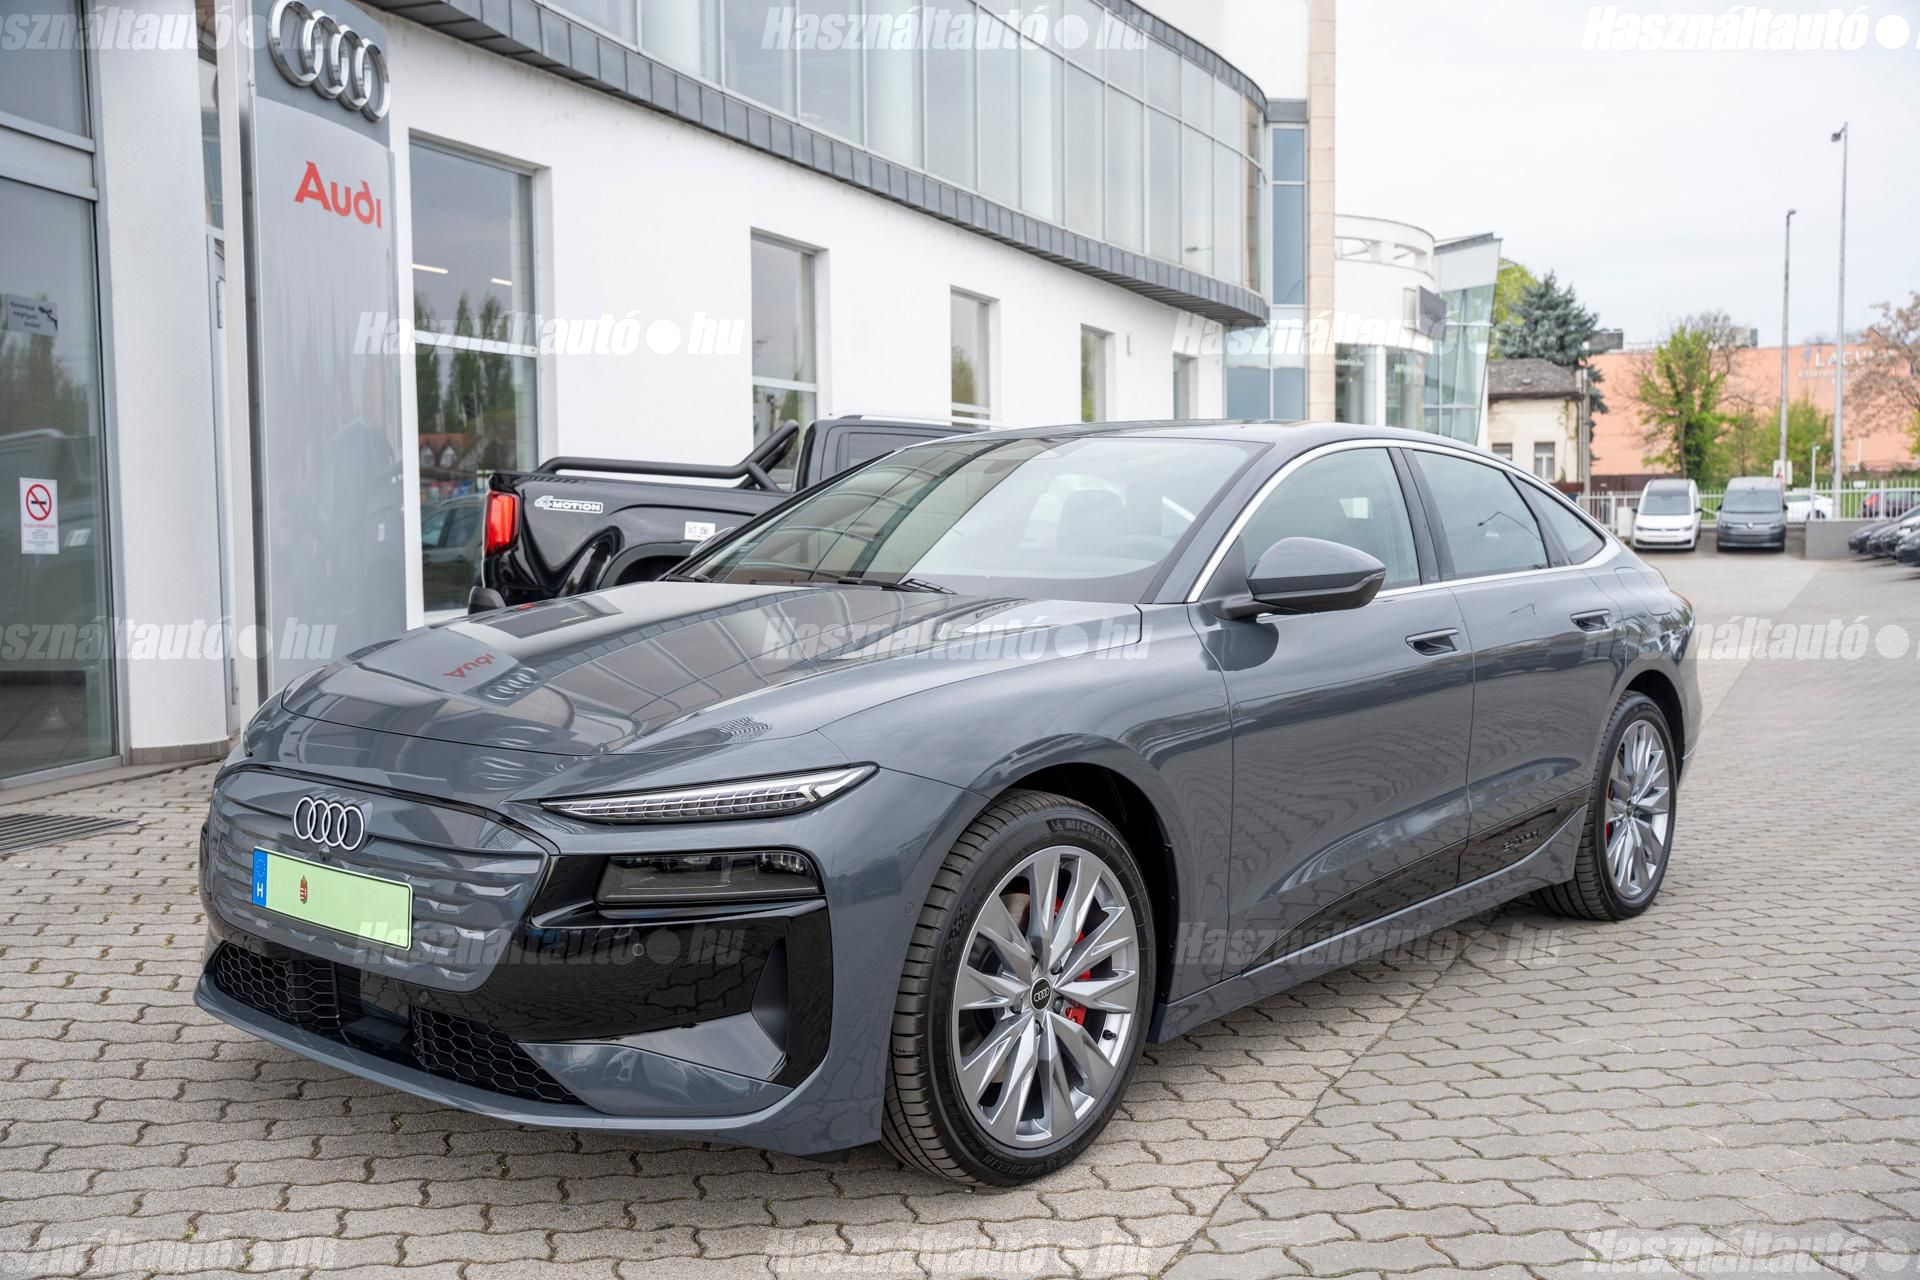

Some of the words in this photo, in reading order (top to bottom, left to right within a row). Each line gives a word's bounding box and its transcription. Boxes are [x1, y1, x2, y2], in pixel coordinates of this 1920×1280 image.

[294, 160, 382, 228] Audi
[534, 495, 603, 513] 4MOTION
[1065, 820, 1117, 849] MICHELIN
[256, 882, 264, 898] H
